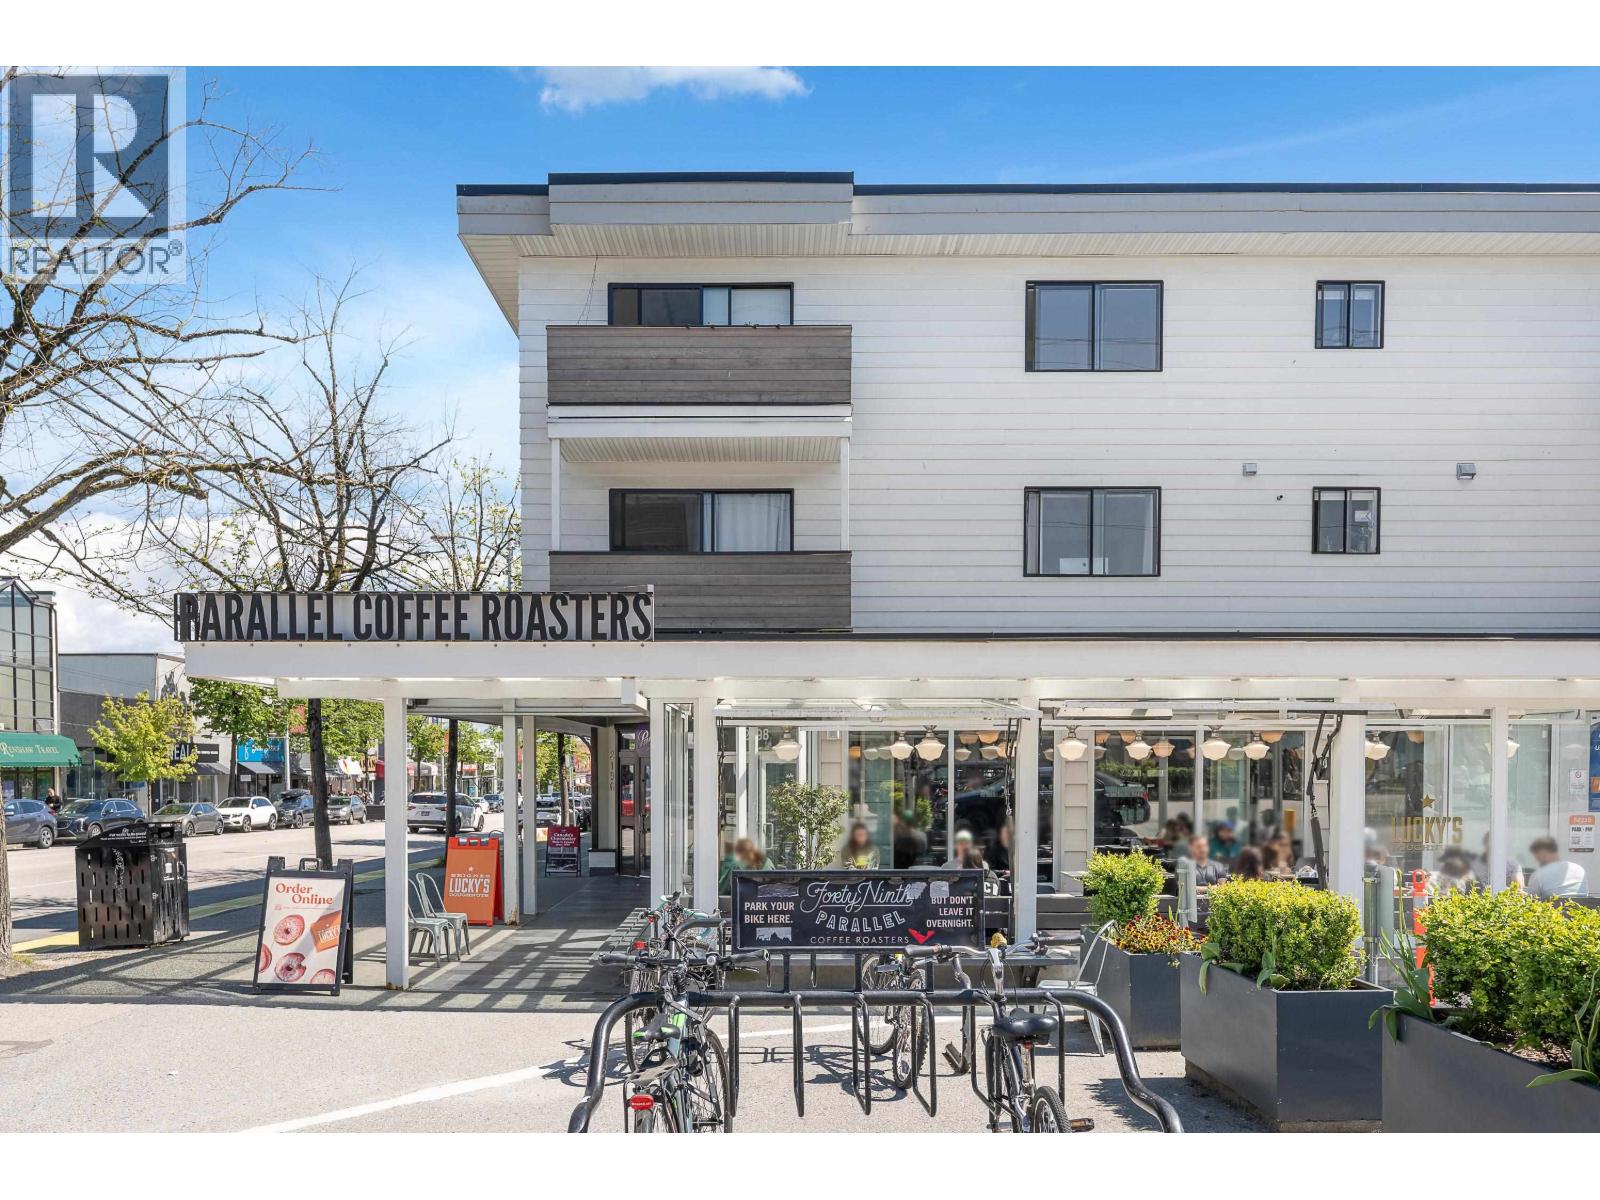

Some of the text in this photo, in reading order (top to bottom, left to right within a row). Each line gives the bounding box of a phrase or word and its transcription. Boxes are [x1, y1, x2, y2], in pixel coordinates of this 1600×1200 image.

[174, 592, 652, 641] PARALLEL COFFEE ROASTERS
[1391, 816, 1463, 844] LUCKY'S
[275, 883, 313, 894] Order
[449, 877, 490, 893] LUCKY'S
[291, 894, 333, 905] Online
[800, 881, 858, 913] Forty
[931, 895, 974, 905] BUT DON'T
[744, 902, 795, 911] PARK YOUR
[939, 907, 974, 916] LEAVE IT
[744, 914, 793, 924] BIKE HERE.
[815, 910, 906, 933] PARALLEL
[926, 919, 974, 928] OVERNIGHT.
[810, 936, 909, 944] COFFEE ROASTERS
